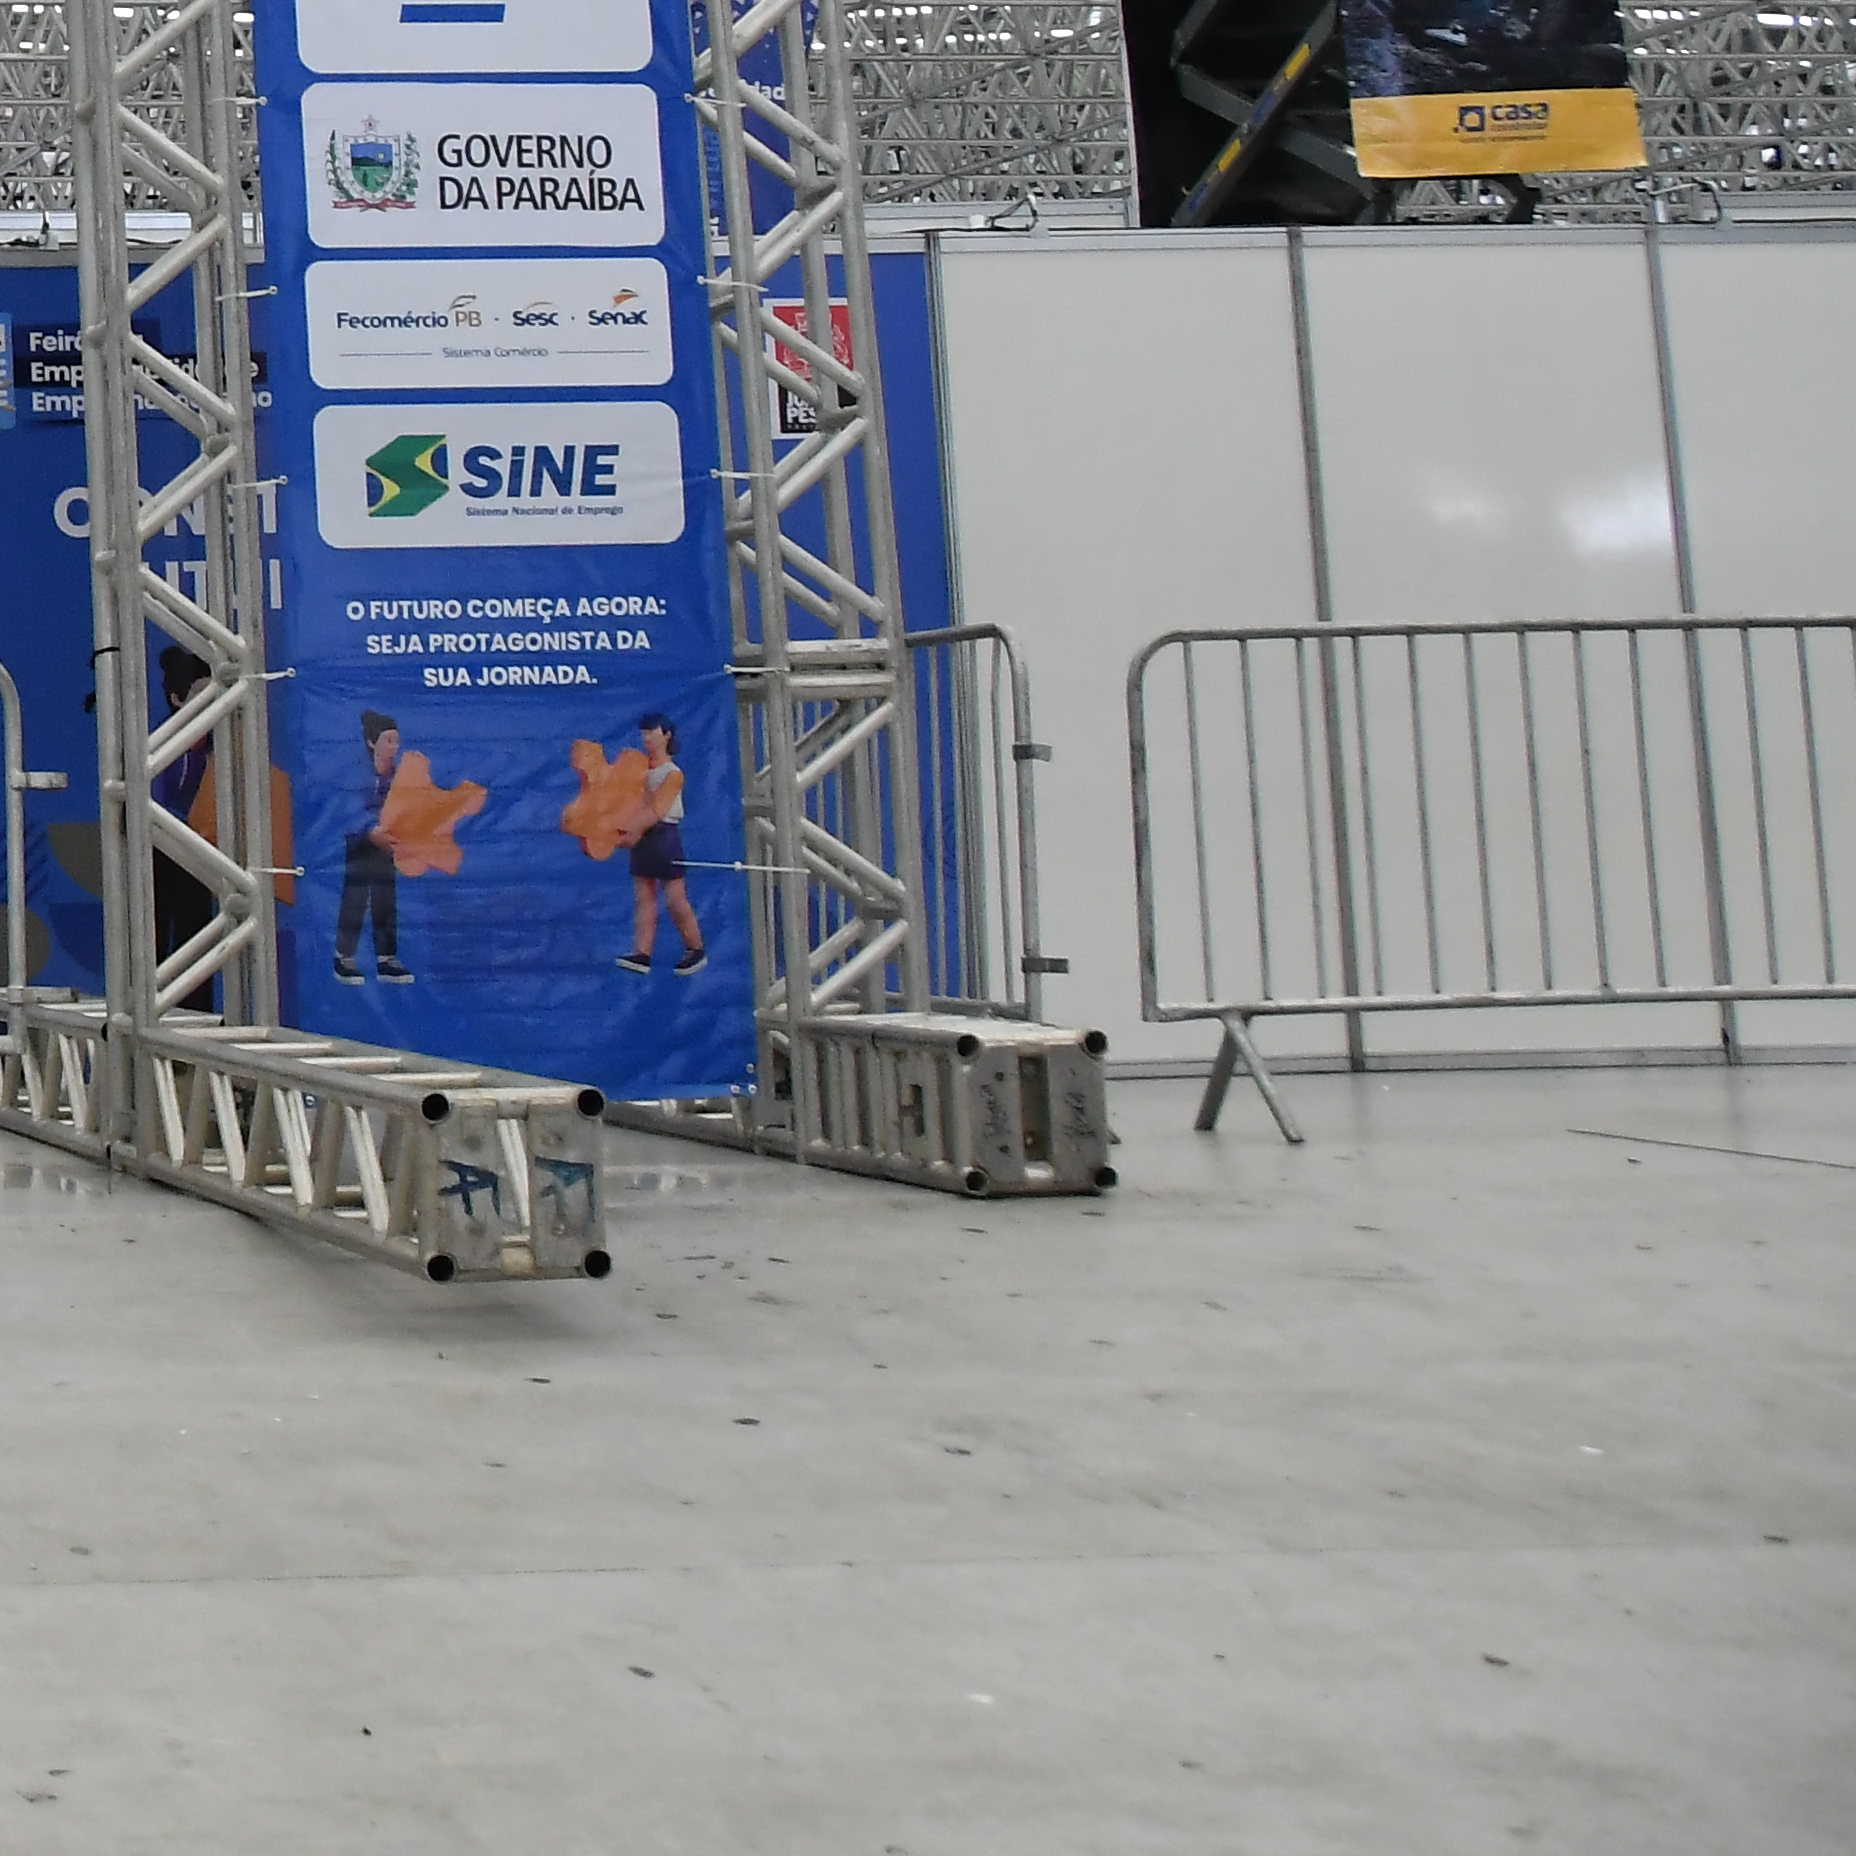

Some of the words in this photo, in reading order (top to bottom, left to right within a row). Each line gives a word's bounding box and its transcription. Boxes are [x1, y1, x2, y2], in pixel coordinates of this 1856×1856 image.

[437, 133, 613, 169] GOVERNO
[439, 175, 489, 211] DA
[496, 169, 646, 212] PARAÍBA
[337, 310, 449, 329] Fecomércio
[454, 310, 483, 328] PB
[512, 309, 560, 328] Sesc
[587, 308, 650, 327] Senac
[442, 346, 492, 359] Sistema
[494, 346, 549, 358] Comércio
[465, 506, 509, 517] Sistema
[511, 505, 559, 517] Nacional
[561, 505, 574, 516] de
[346, 600, 366, 621] O
[369, 599, 463, 621] FUTURO
[466, 597, 571, 624] COMEÇA
[575, 596, 667, 617] AGORA:
[366, 633, 424, 655] SEJA
[428, 630, 613, 654] PROTAGONISTA
[616, 629, 651, 651] DA
[423, 666, 472, 688] SUA
[476, 664, 598, 688] JORNADA.
